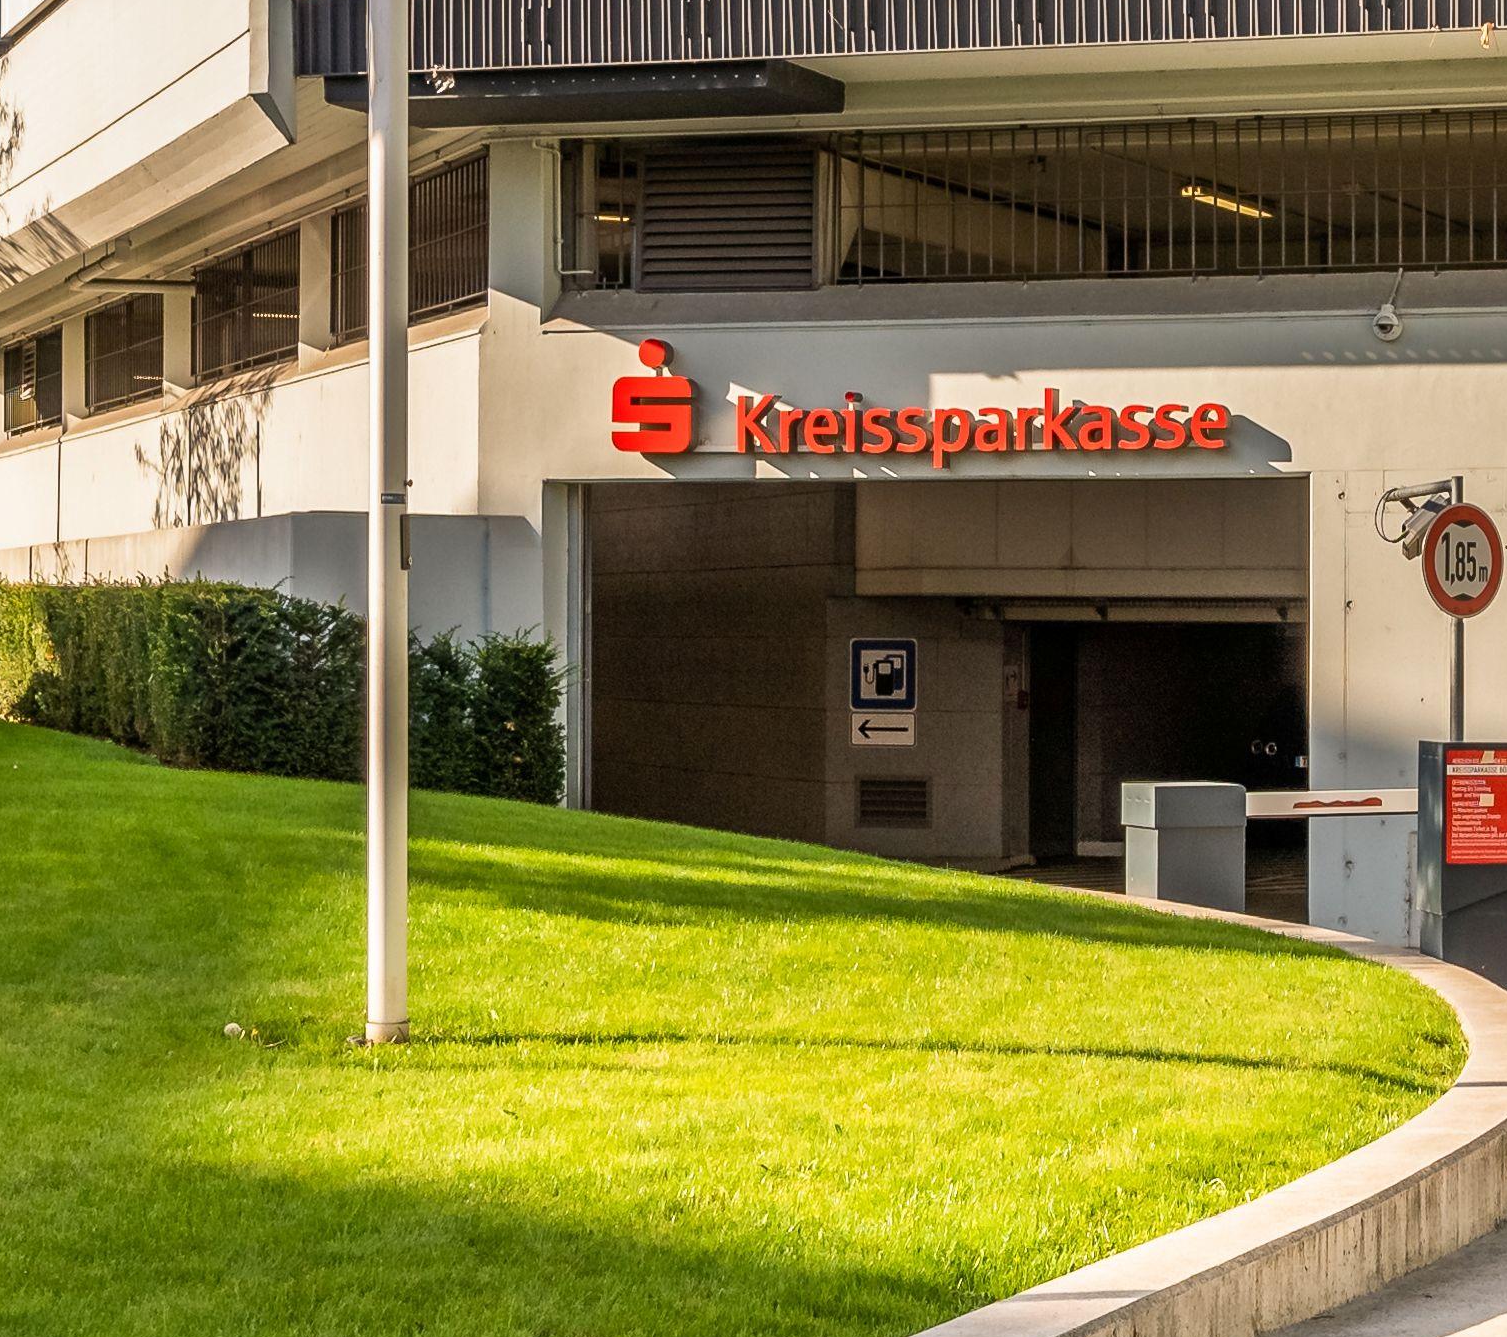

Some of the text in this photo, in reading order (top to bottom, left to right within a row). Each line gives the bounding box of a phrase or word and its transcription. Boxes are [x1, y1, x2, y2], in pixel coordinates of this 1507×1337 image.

[736, 388, 1229, 469] Kreissparkasse
[1441, 531, 1489, 586] 1,85 m
